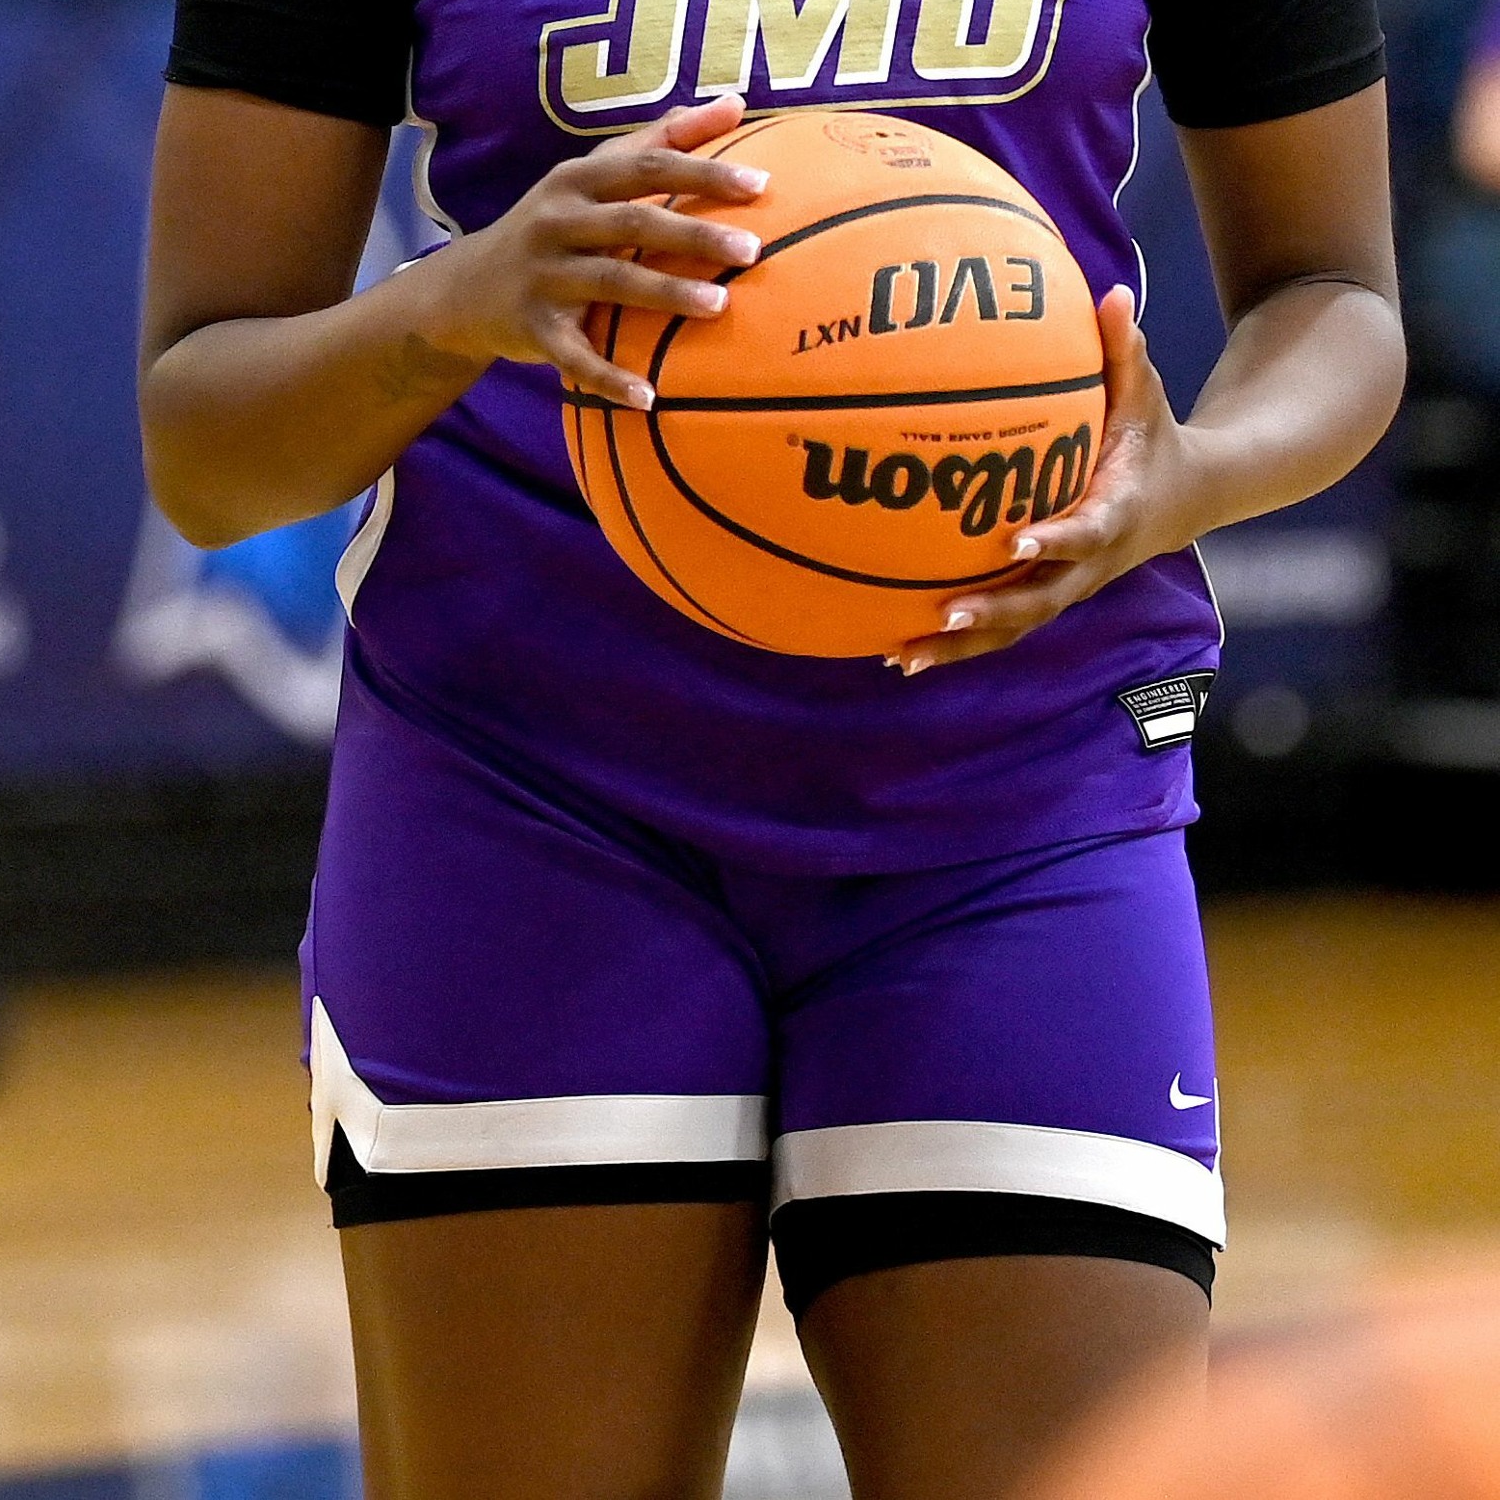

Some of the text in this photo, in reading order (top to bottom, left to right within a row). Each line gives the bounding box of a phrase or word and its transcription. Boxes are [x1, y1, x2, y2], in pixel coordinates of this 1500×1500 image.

[790, 255, 1045, 356] EVO NXT
[900, 419, 1050, 443] INDOOR GAME BALL
[802, 422, 1091, 537] Wilson
[1126, 682, 1187, 704] ENGINEERED
